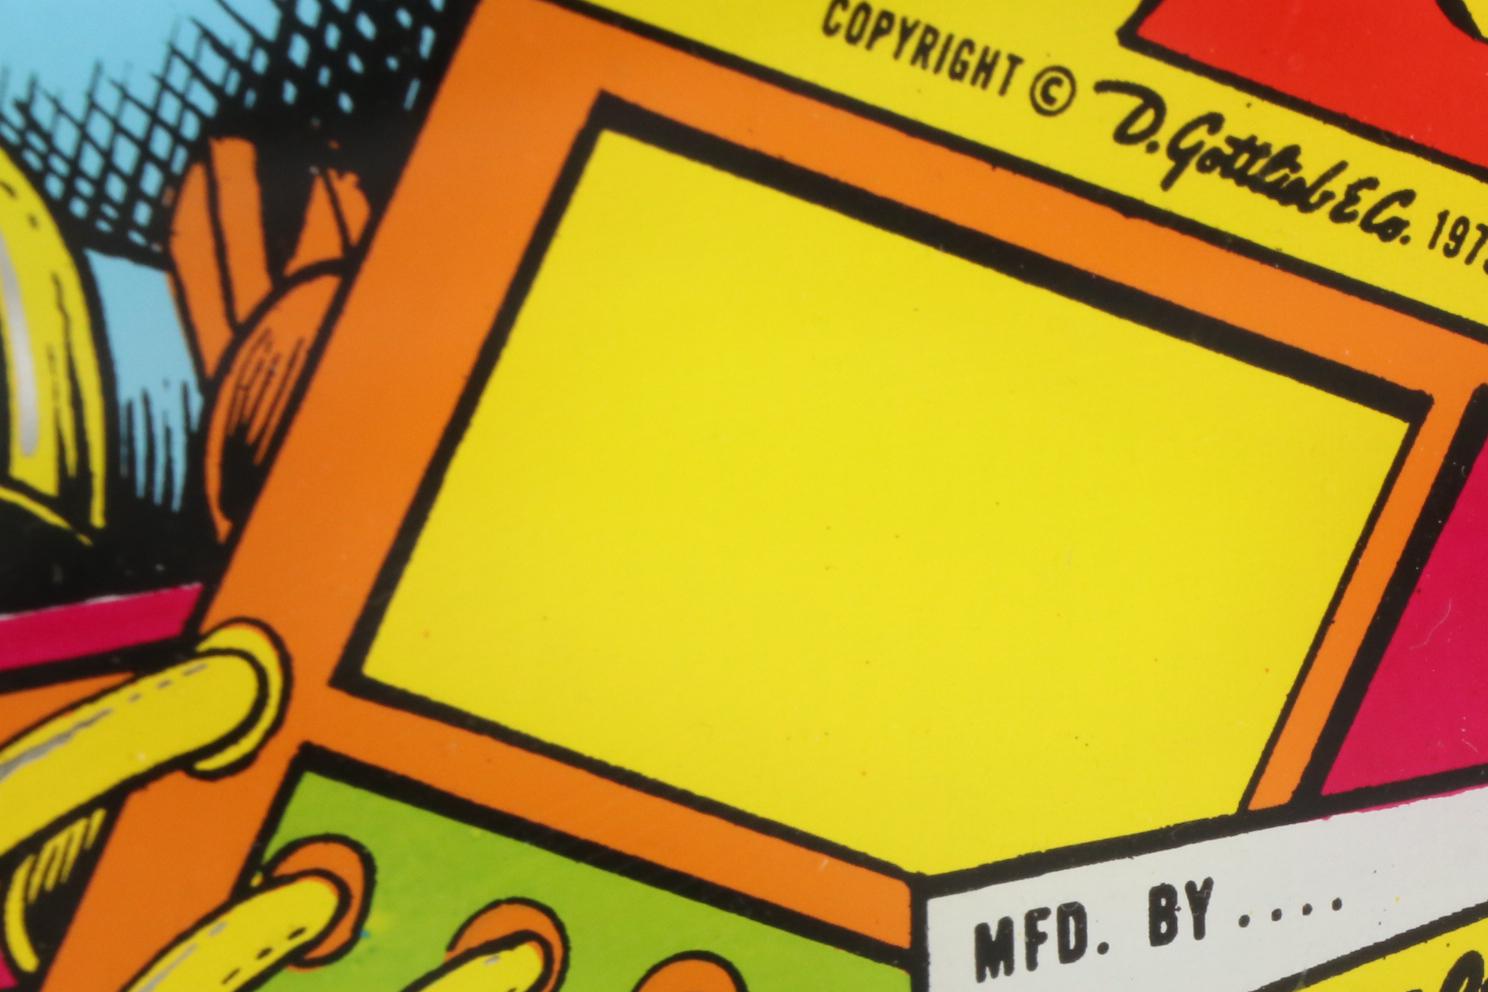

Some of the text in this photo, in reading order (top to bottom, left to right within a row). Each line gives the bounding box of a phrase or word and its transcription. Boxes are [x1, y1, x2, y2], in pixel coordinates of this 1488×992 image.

[821, 0, 1023, 97] COPYRIGHT
[1093, 80, 1167, 153] D.
[1161, 112, 1348, 212] Gottlieb
[1360, 190, 1413, 244] Co.
[974, 900, 1110, 983] MFD.
